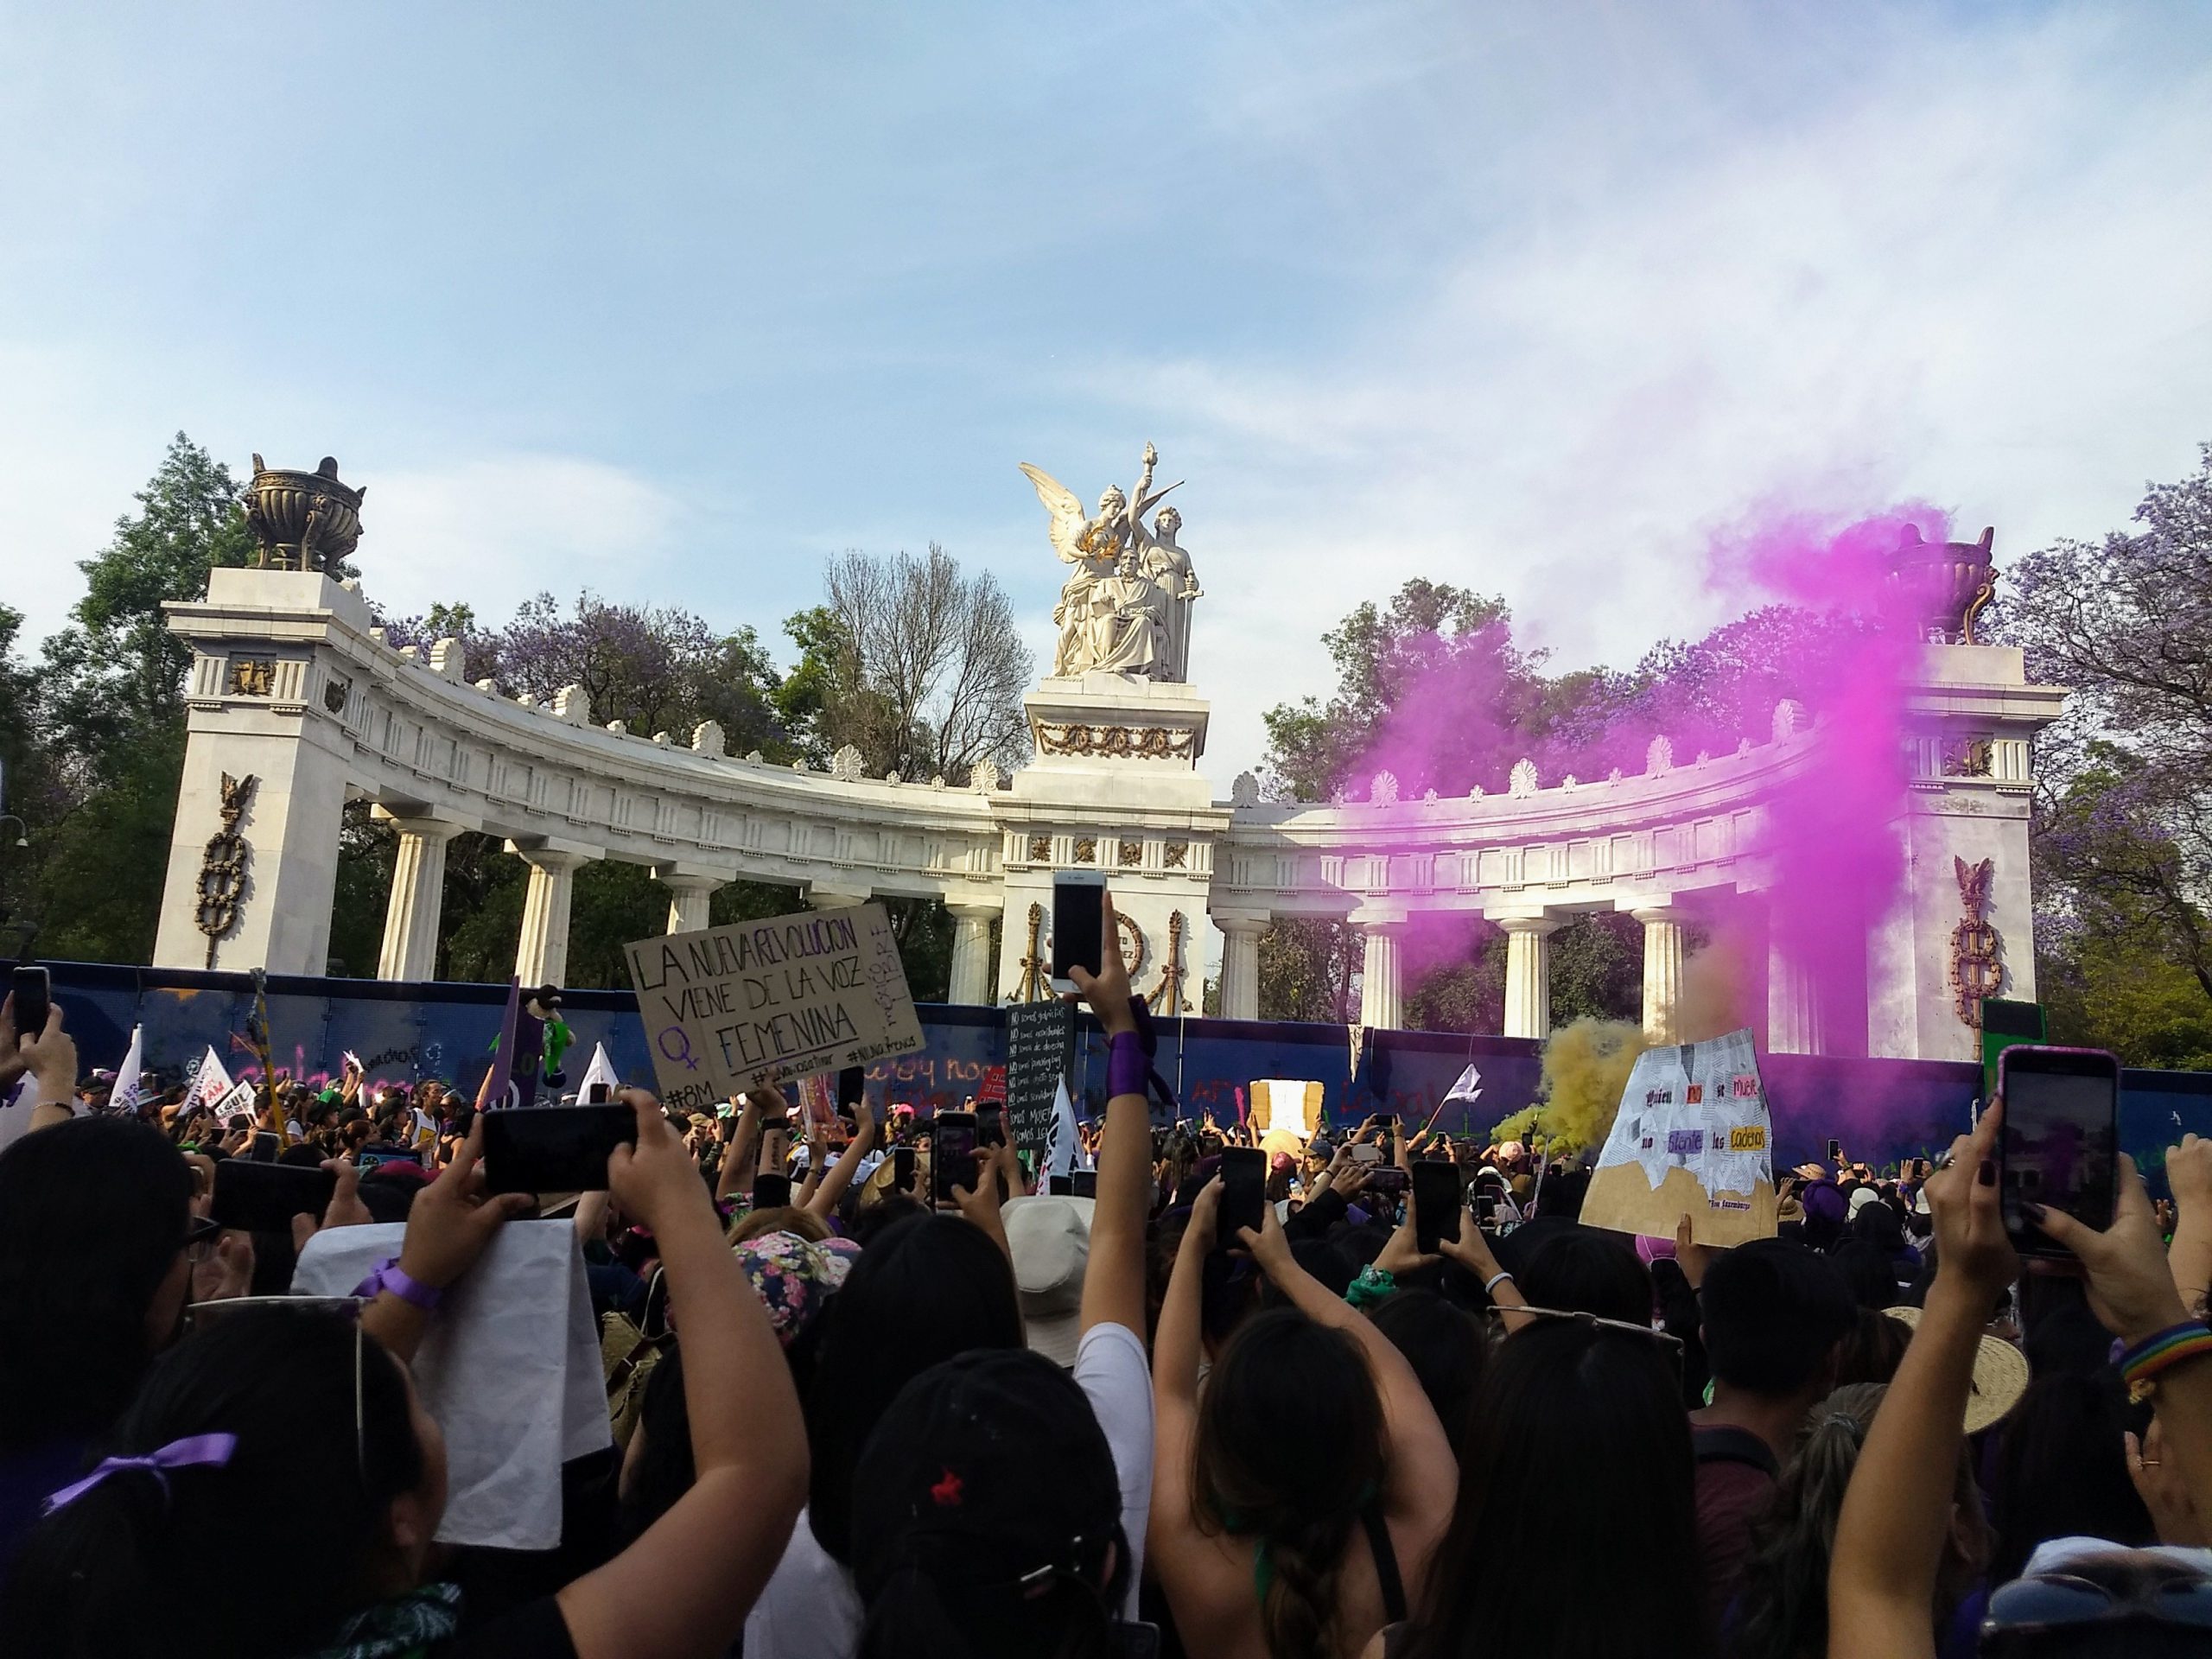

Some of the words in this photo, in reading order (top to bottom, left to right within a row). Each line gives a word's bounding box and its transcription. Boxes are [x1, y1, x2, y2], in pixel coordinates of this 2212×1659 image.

[632, 944, 690, 991] LA
[689, 933, 759, 978] NUEVA
[754, 917, 858, 967] REVOLUCION
[663, 982, 735, 1022] VIENE
[743, 975, 781, 1009] DE
[785, 968, 817, 1000] LA
[816, 956, 866, 992] VOZ
[1011, 1011, 1020, 1024] NO
[715, 1002, 858, 1068] FEMENINA
[1010, 1027, 1019, 1040] NO
[1009, 1044, 1017, 1055] NO
[1008, 1061, 1018, 1073] NO
[1008, 1077, 1016, 1088] NO
[666, 1080, 715, 1109] #8M
[1007, 1092, 1015, 1104] NO
[1712, 1132, 1725, 1150] las
